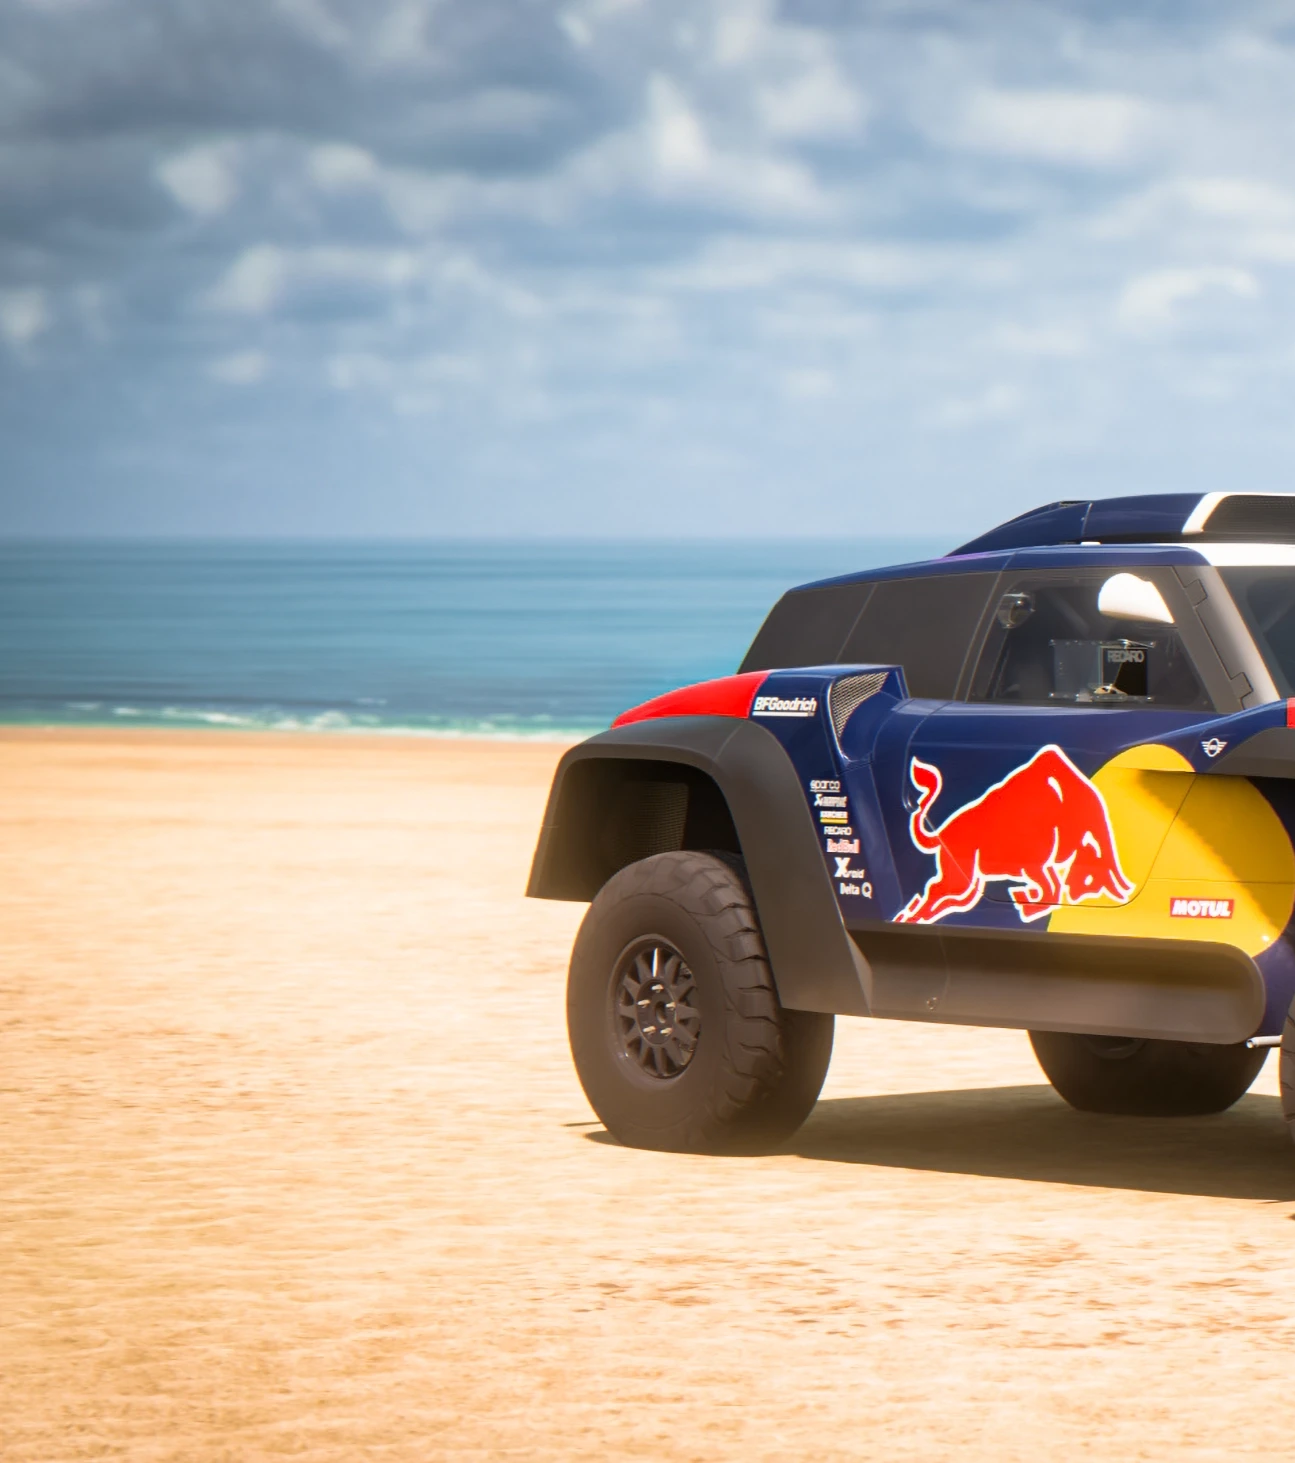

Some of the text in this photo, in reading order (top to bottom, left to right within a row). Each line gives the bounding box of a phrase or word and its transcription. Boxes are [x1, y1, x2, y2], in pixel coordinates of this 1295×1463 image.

[753, 697, 818, 711] BFGoodrich
[862, 881, 873, 899] Q
[1172, 900, 1231, 917] MOTUL
